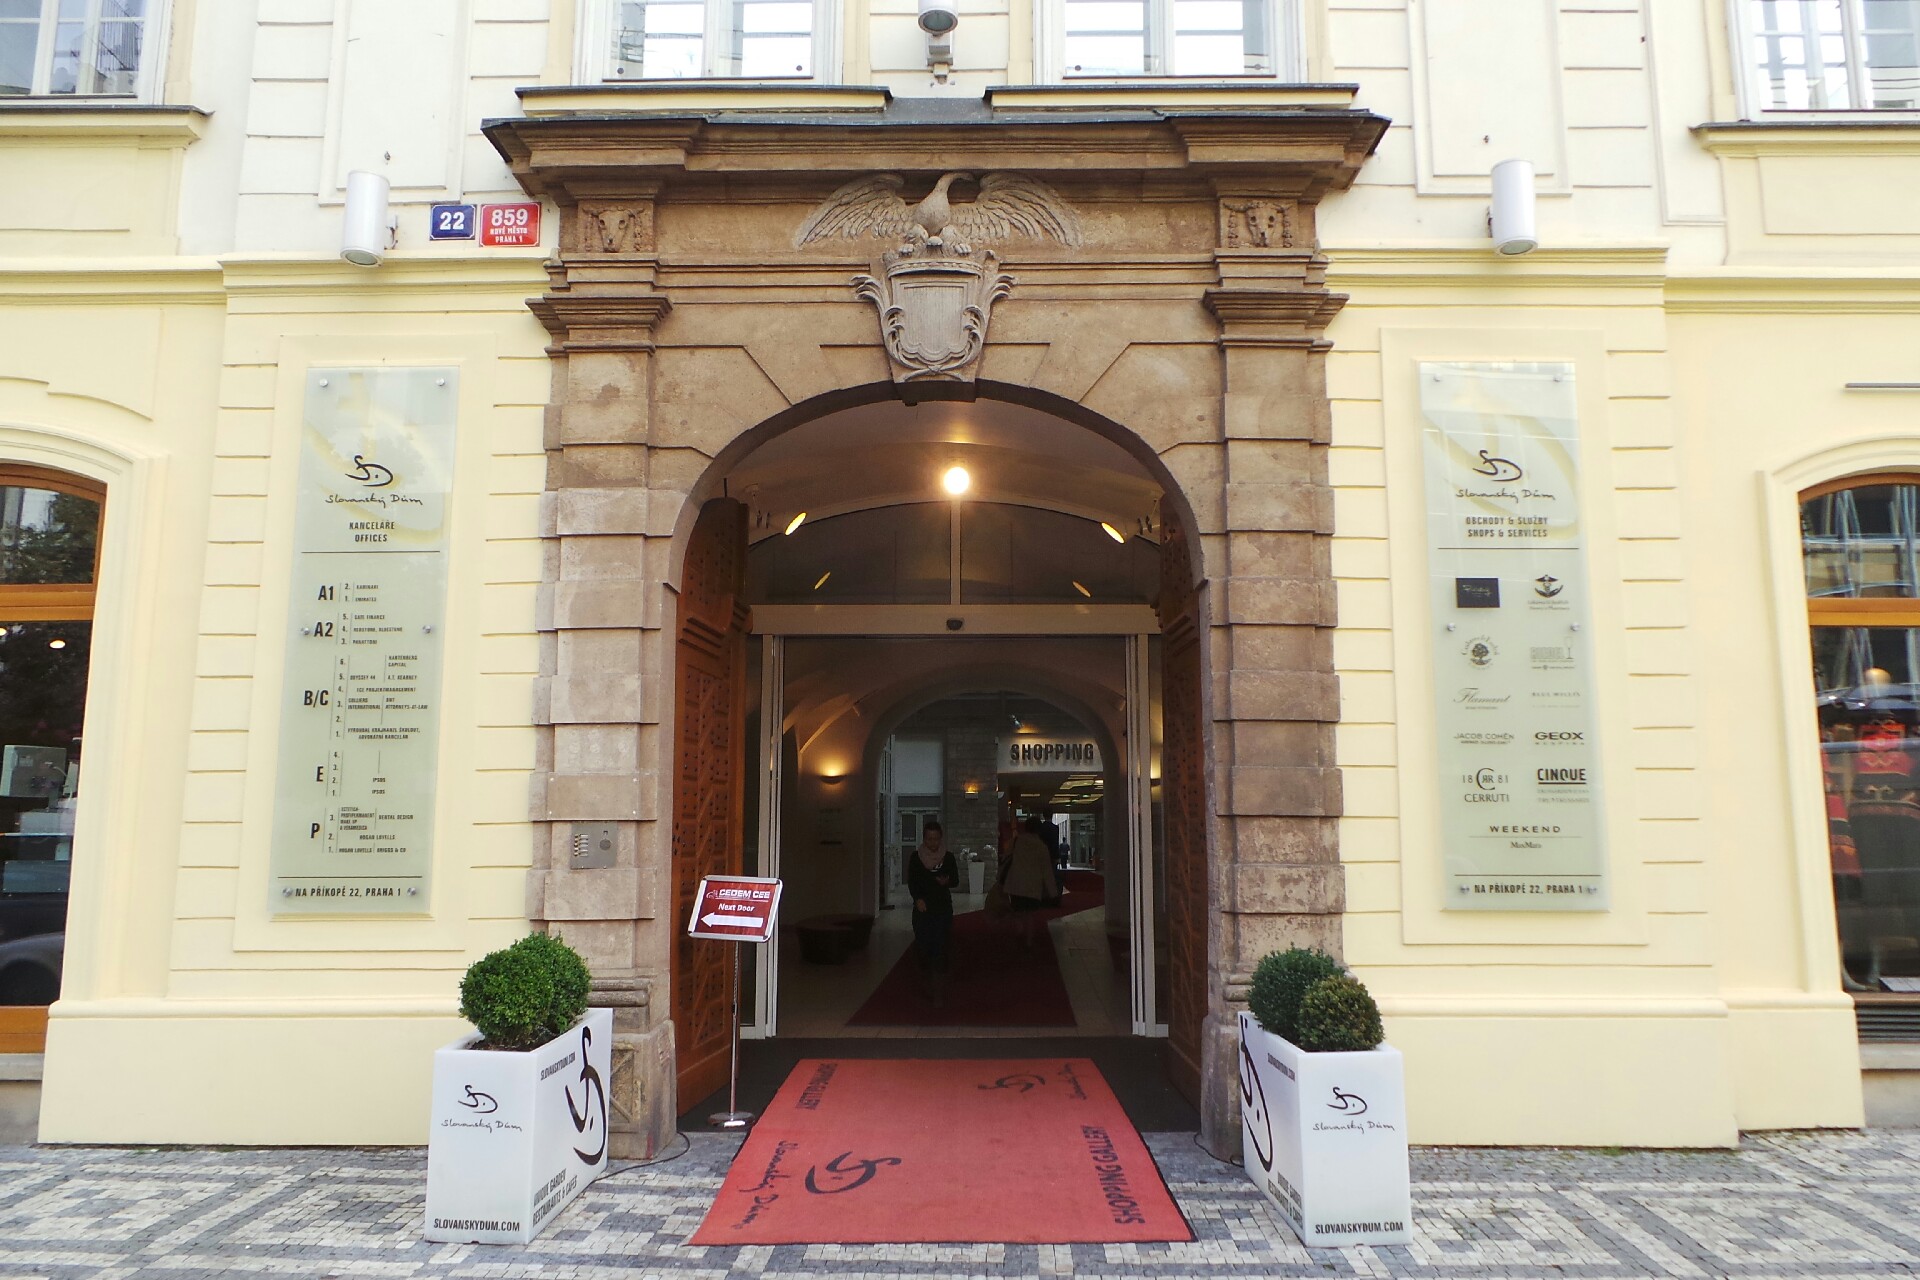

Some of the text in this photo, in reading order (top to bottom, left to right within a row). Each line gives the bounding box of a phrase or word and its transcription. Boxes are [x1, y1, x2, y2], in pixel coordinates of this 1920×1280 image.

[440, 212, 464, 230] 22
[492, 208, 528, 226] 859
[490, 226, 527, 234] NOVÉ MĚSTO
[1518, 516, 1548, 524] SLUŽBY
[354, 534, 388, 542] OFFICES
[318, 585, 334, 600] A1
[314, 622, 333, 637] A2
[304, 690, 329, 708] B/C
[1535, 732, 1583, 740] GEOX
[1011, 744, 1094, 760] SHOPPING
[316, 766, 323, 782] E
[1538, 768, 1586, 780] CINQUE
[1464, 794, 1510, 802] CERRUTI
[310, 823, 320, 839] P
[295, 888, 306, 896] NA
[349, 888, 362, 897] 22,
[365, 888, 393, 896] PRAHA
[397, 888, 401, 896] 1
[1475, 885, 1486, 893] NA
[1530, 885, 1543, 894] 22,
[1547, 885, 1575, 893] PRAHA
[1081, 1125, 1145, 1224] SHOPPING GALLERY
[434, 1218, 520, 1232] SLOVANSKYDUM.COM
[1315, 1222, 1403, 1234] SLOVANSKYDUM.COM
